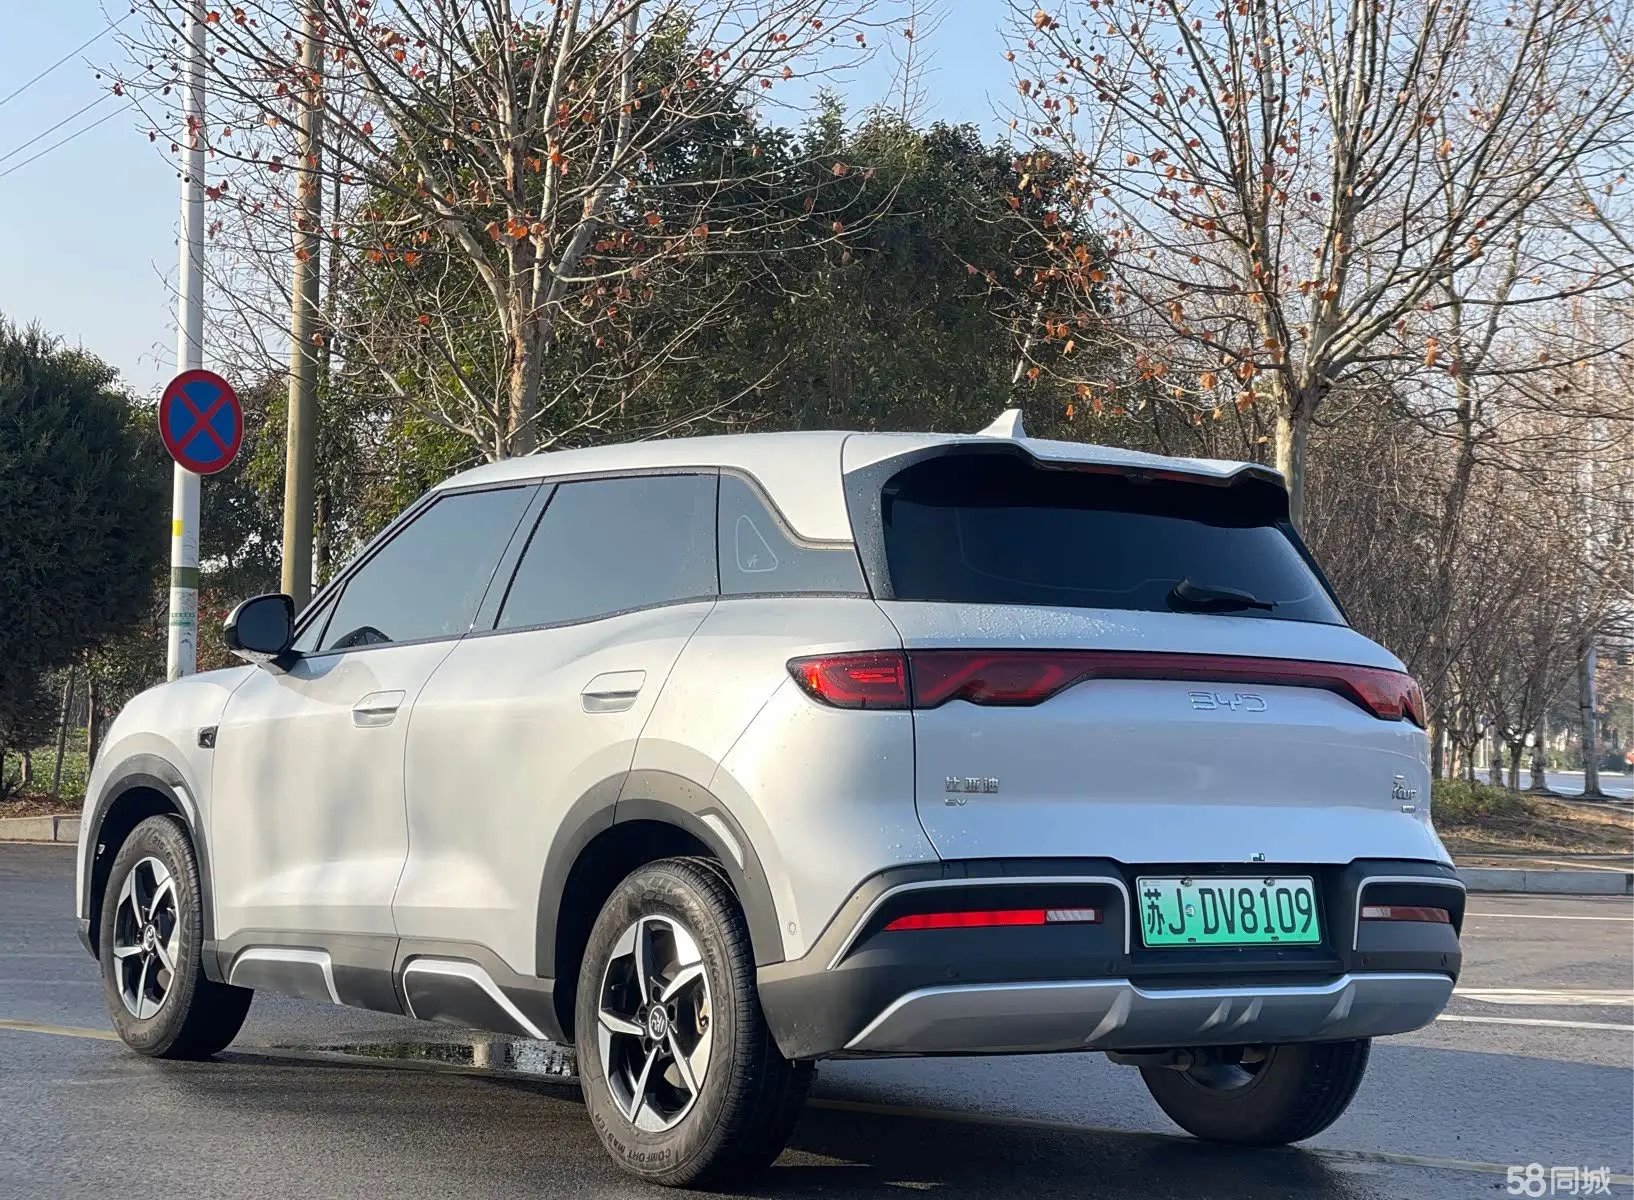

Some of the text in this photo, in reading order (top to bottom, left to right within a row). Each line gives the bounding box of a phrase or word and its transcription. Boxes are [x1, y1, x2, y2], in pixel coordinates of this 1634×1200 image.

[1188, 692, 1267, 712] BYD
[945, 776, 999, 793] 比亚迪
[945, 798, 967, 807] EV
